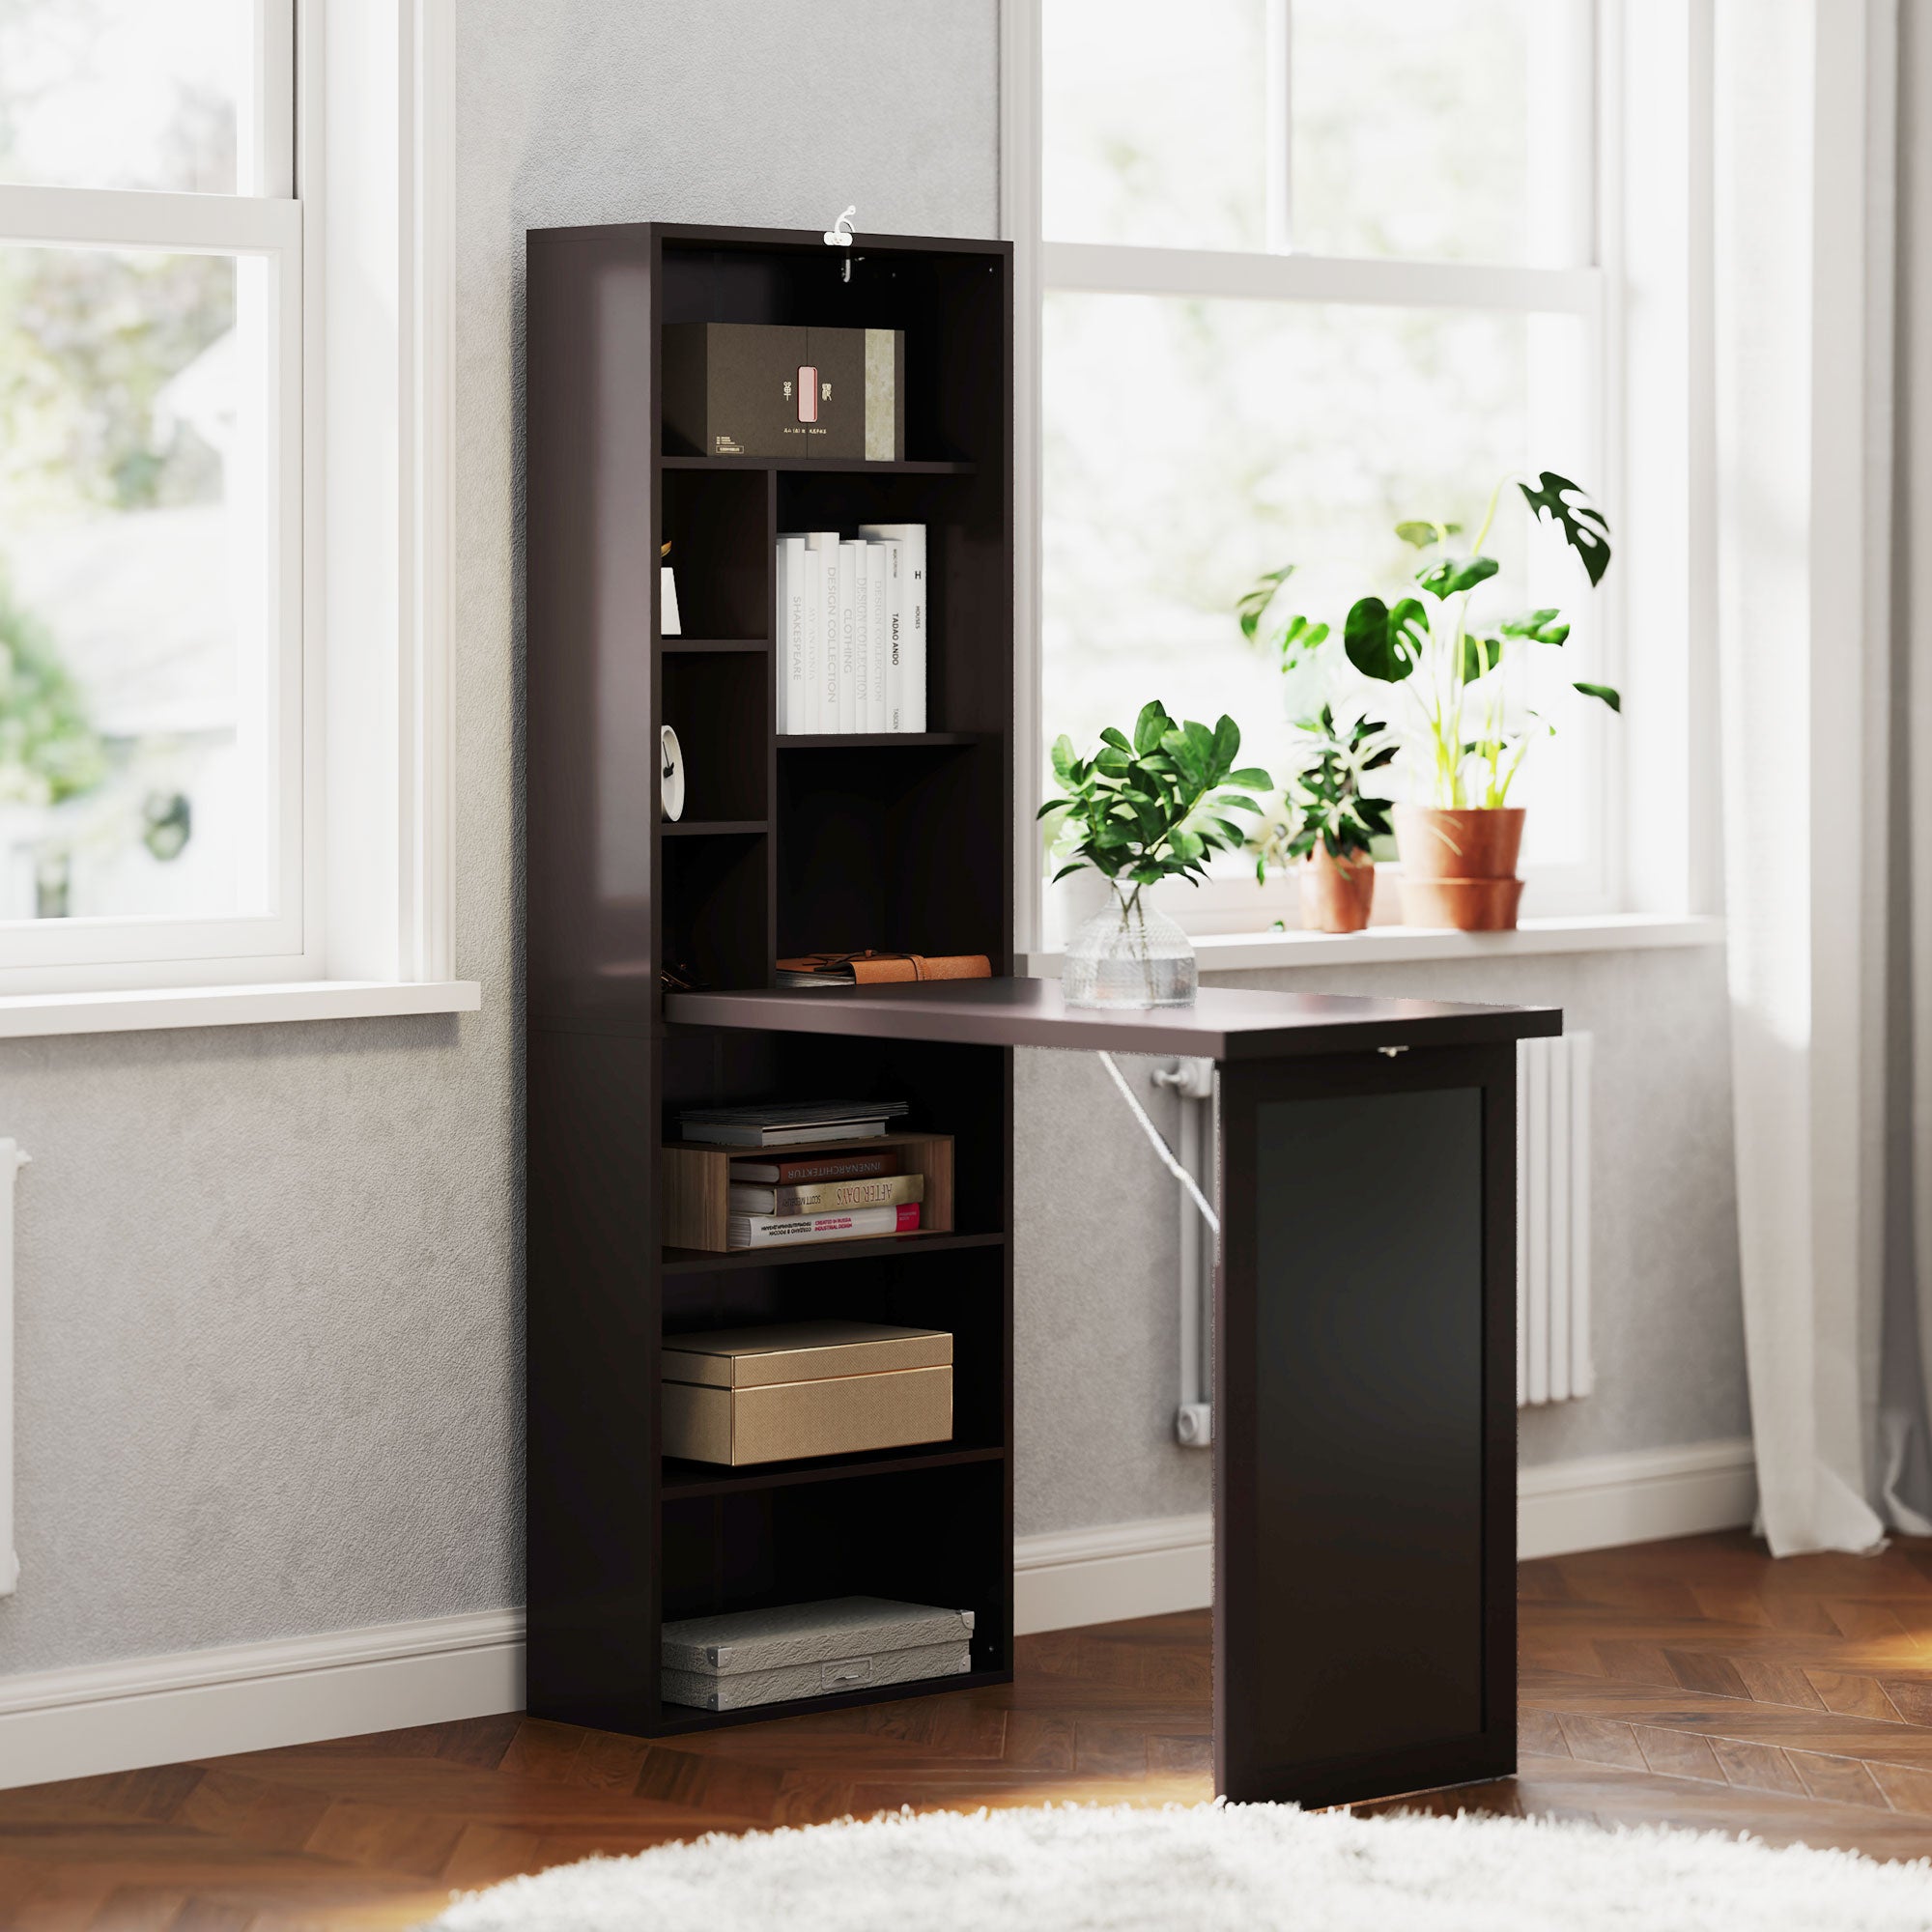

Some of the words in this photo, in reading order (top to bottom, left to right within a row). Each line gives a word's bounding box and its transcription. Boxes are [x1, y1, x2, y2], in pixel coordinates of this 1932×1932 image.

[827, 567, 837, 615] DESIGN
[856, 577, 867, 623] DESIGN
[873, 581, 883, 625] DESIGN
[792, 595, 802, 681] SHAKESPEARE
[827, 619, 837, 703] COLLECTION
[843, 608, 853, 674] CLOTHING
[856, 626, 867, 701] COLLECTION
[873, 628, 883, 702] COLLECTION
[788, 1161, 881, 1179] INNENARCHITEKTUR
[865, 1183, 893, 1203] AFTER
[806, 1194, 821, 1206] SCOTT
[837, 1186, 860, 1205] DAYS
